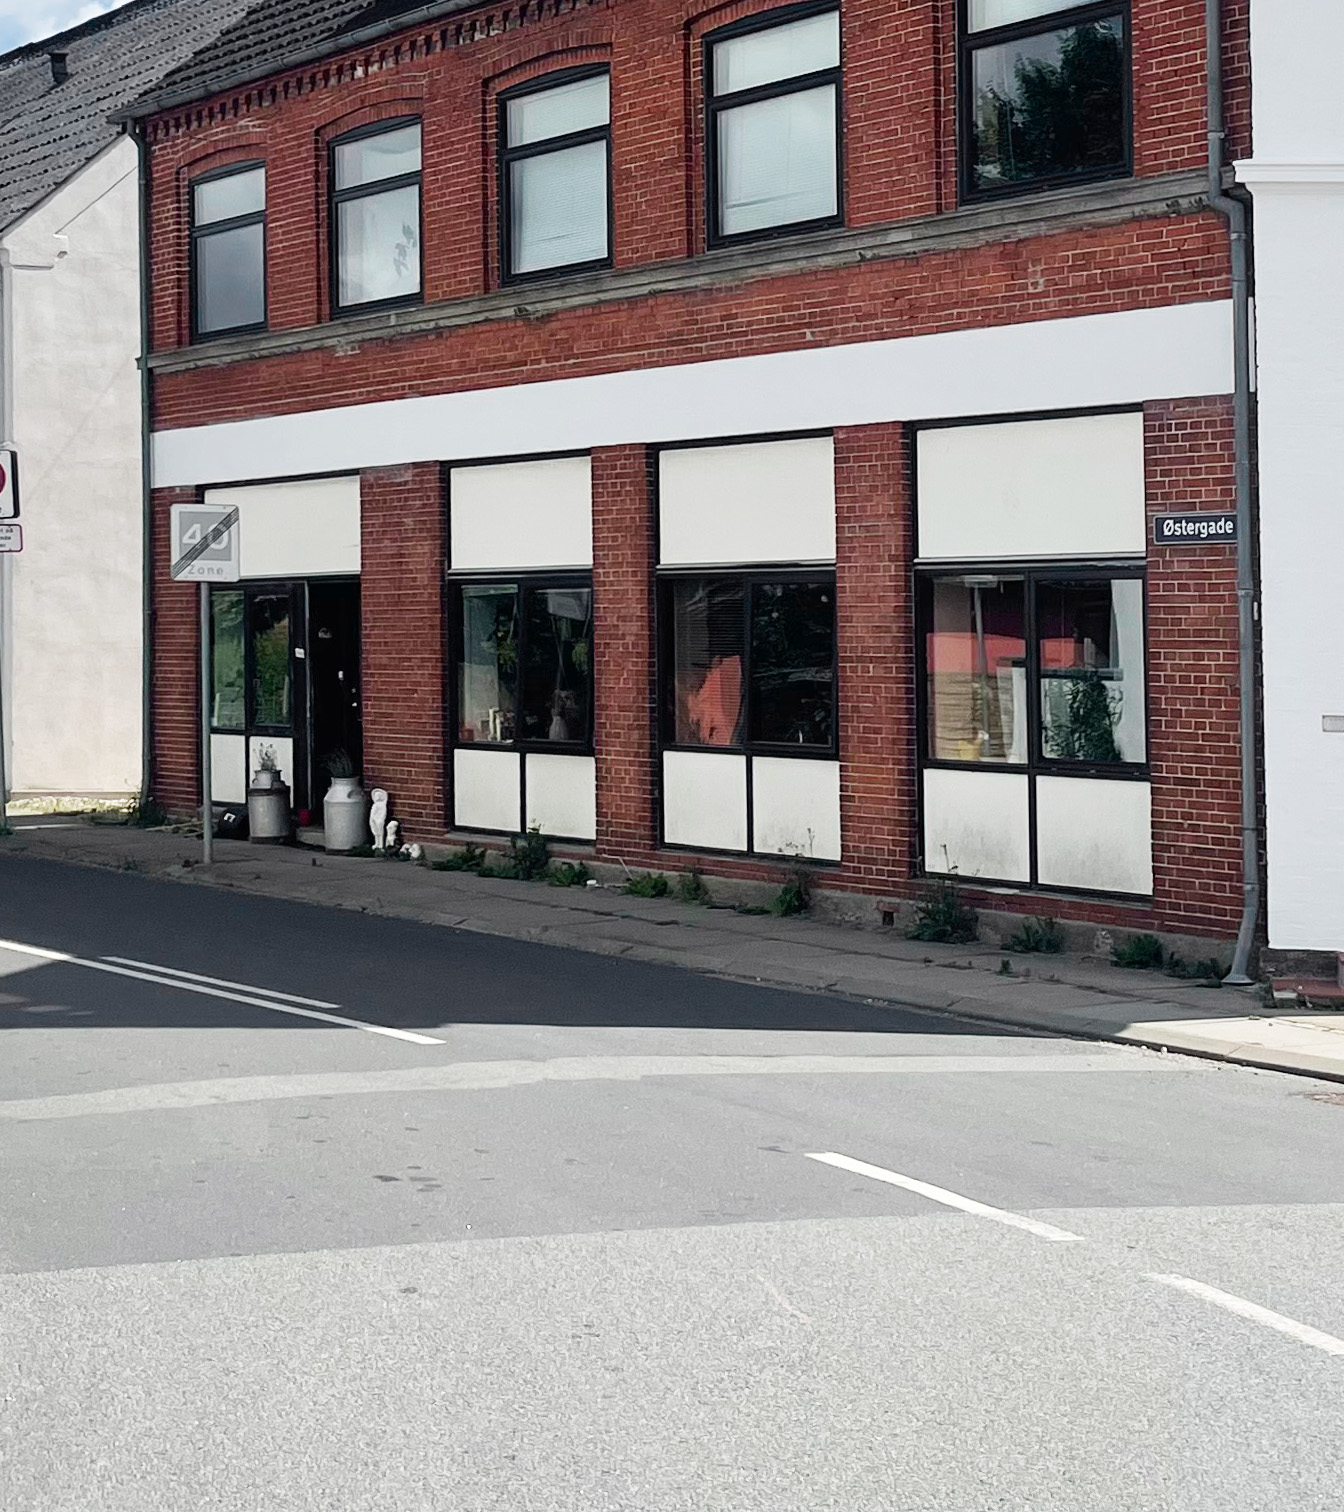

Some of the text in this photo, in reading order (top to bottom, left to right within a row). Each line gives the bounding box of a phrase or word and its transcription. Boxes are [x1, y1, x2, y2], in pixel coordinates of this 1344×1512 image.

[182, 523, 229, 550] 40
[1163, 517, 1234, 538] Østergade
[188, 564, 224, 575] Zone
